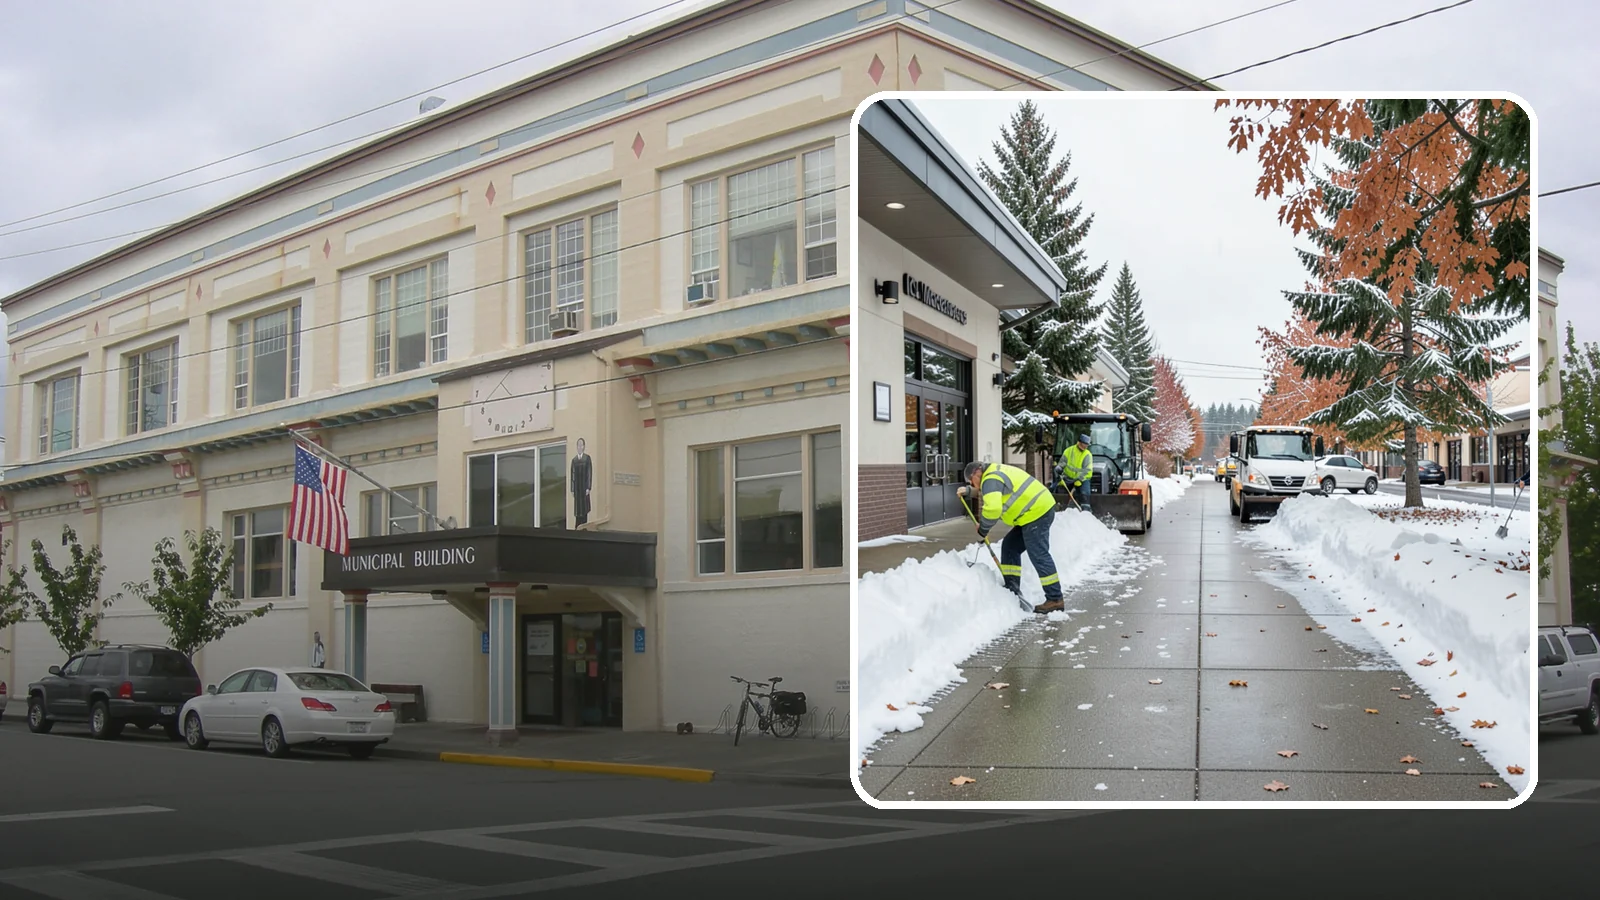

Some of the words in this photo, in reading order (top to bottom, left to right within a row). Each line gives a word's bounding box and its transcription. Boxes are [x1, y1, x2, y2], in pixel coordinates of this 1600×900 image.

[536, 402, 540, 410] 4
[480, 407, 485, 415] 8
[488, 418, 492, 426] 9
[528, 414, 533, 422] 3
[521, 420, 525, 428] 2
[508, 426, 513, 434] 12
[342, 552, 405, 572] MUNICIPAL
[414, 546, 475, 568] BUILDING
